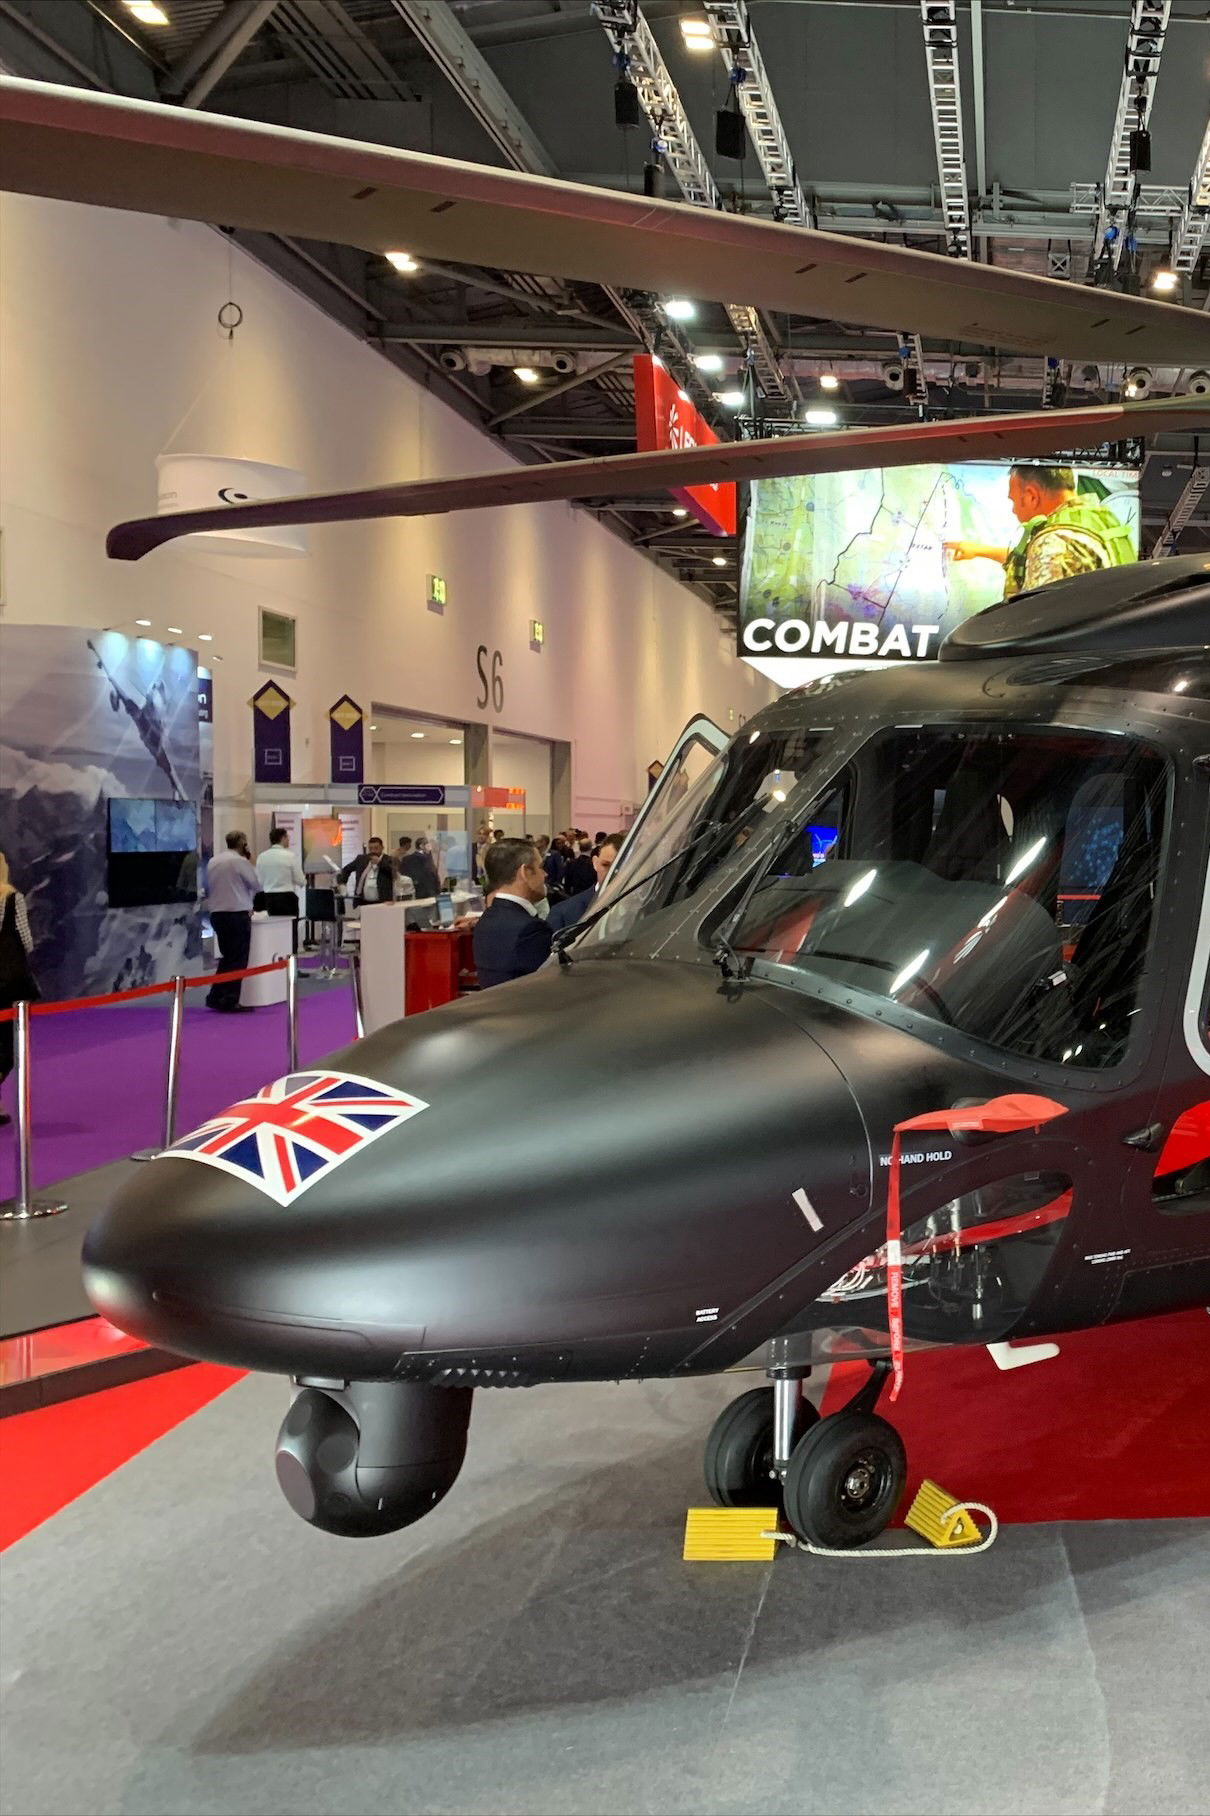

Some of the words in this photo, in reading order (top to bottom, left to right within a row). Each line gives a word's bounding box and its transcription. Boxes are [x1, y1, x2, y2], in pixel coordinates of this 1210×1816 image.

[743, 618, 939, 657] COMBAT
[477, 645, 503, 713] S6
[926, 1150, 953, 1162] HOLD
